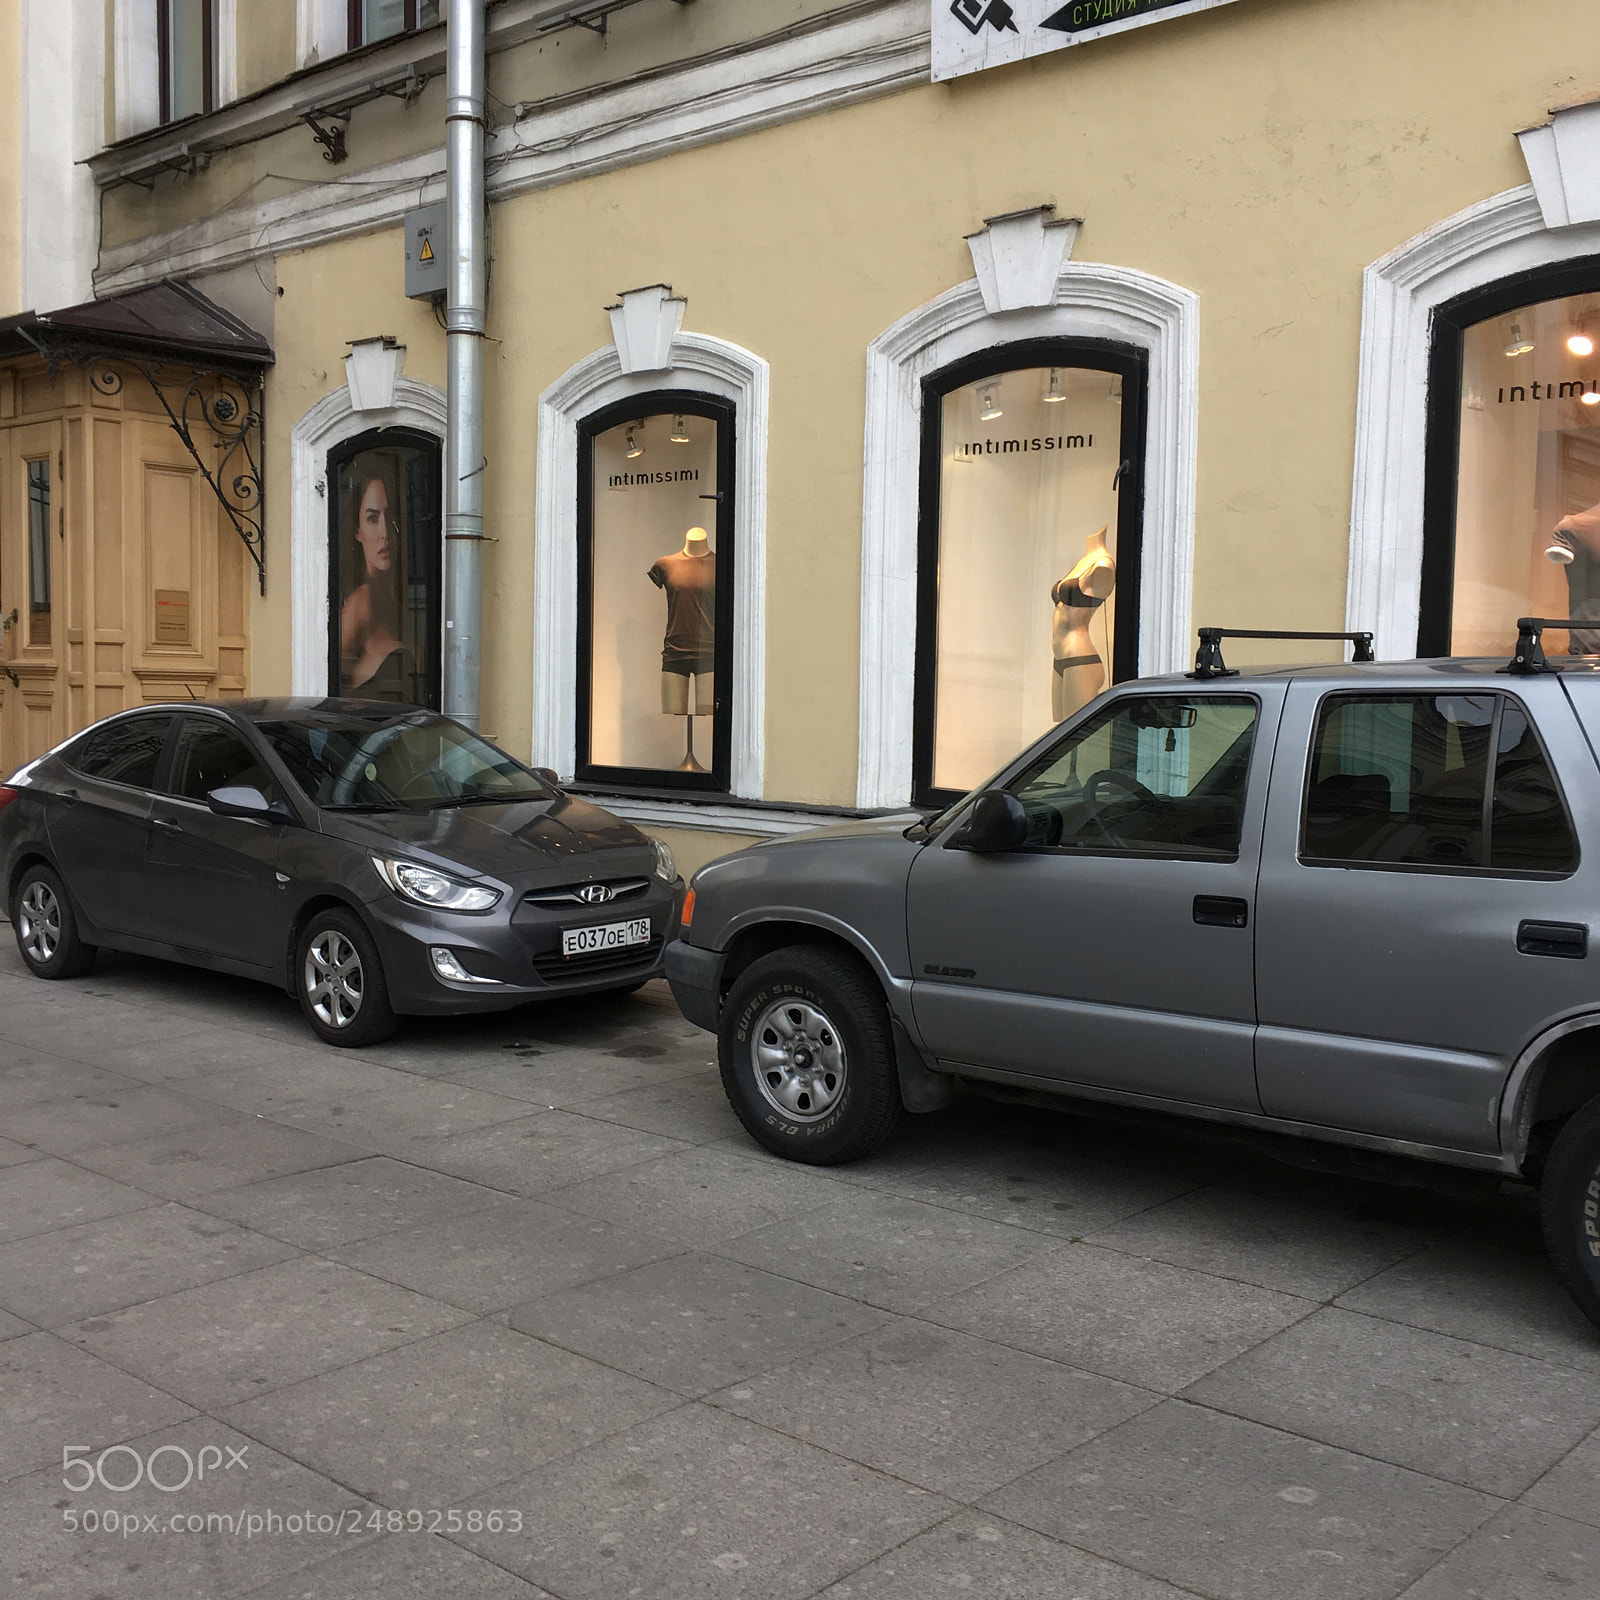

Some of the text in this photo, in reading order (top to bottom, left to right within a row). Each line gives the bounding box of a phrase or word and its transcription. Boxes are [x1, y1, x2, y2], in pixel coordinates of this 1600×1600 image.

[964, 434, 1093, 456] intimissimi
[609, 469, 699, 487] intimissimi
[627, 920, 647, 937] 178
[736, 991, 768, 1042] SUPER
